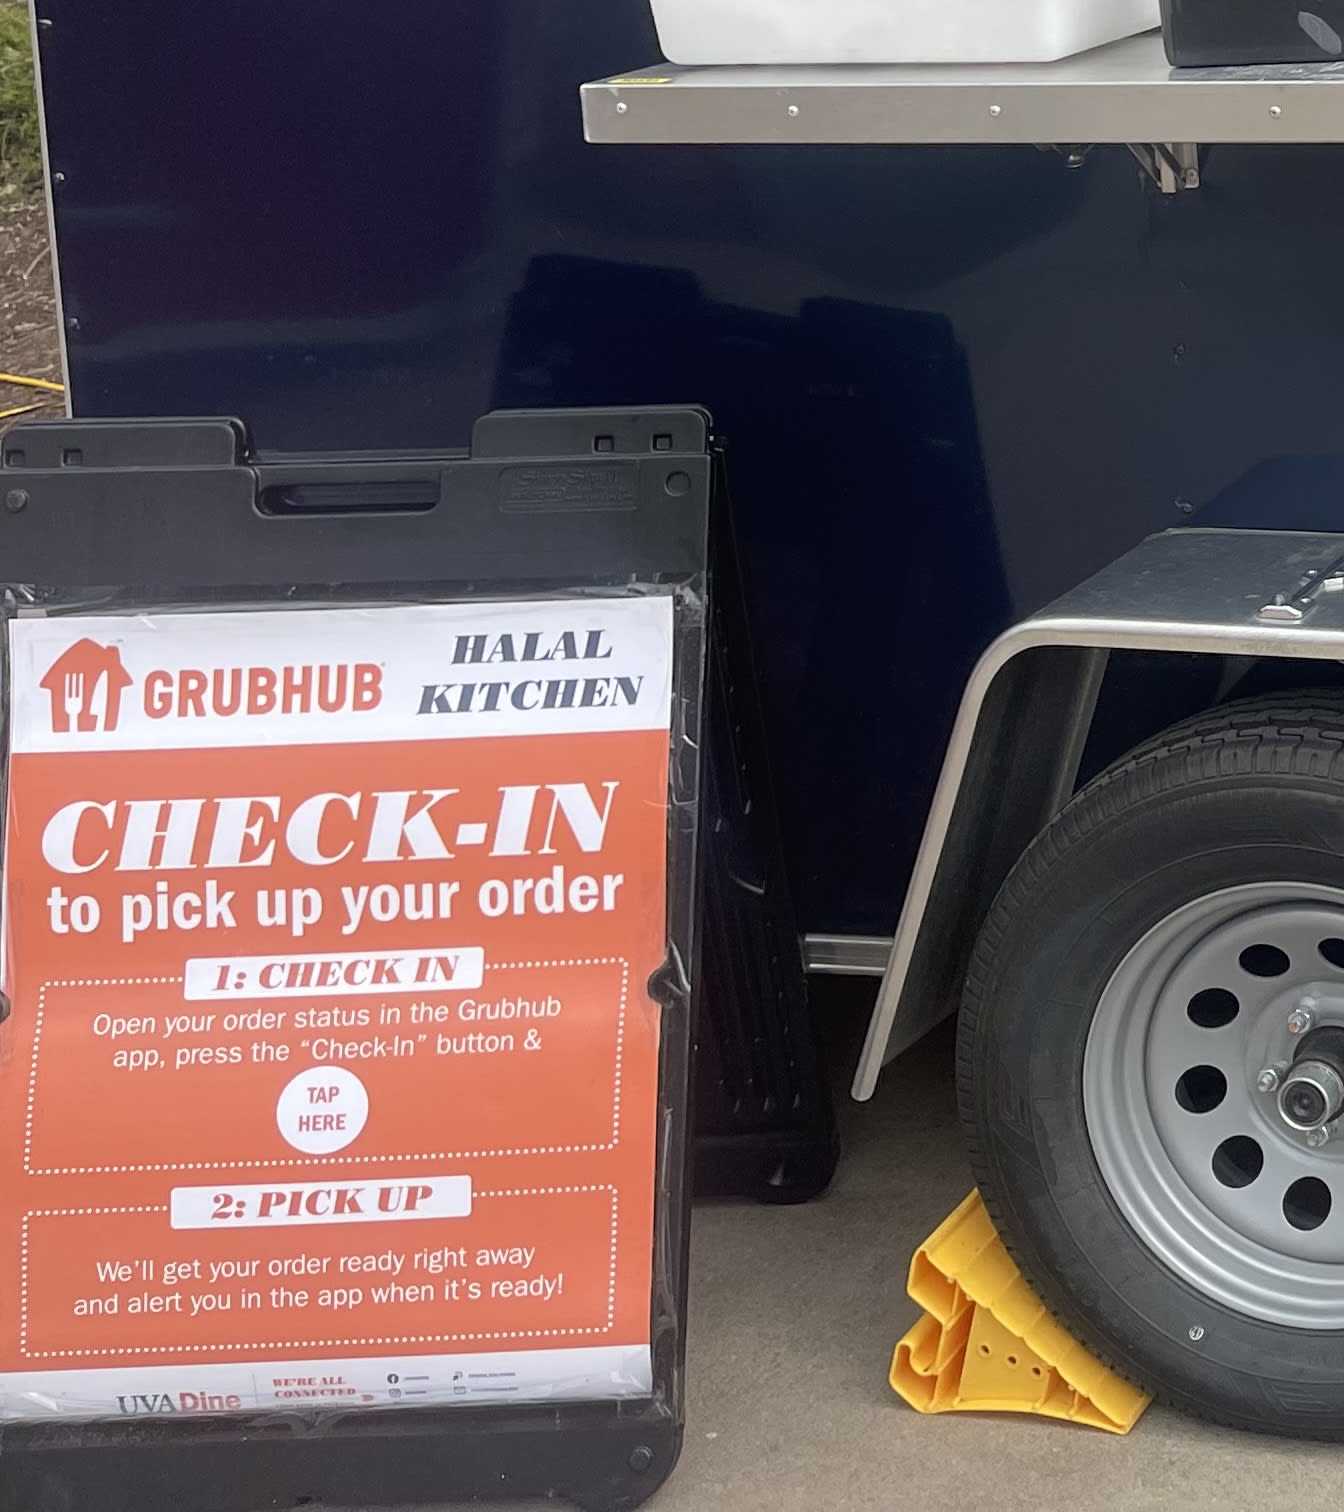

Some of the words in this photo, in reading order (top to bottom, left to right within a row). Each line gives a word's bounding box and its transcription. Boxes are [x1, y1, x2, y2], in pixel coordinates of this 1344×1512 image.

[451, 628, 613, 665] HALAL
[142, 662, 384, 721] GRUBHUB
[416, 674, 644, 716] KITCHEN
[40, 781, 620, 875] CHECK-IN
[47, 888, 100, 934] to
[122, 880, 237, 944] pick
[256, 886, 323, 937] up
[342, 880, 461, 935] your
[479, 865, 624, 917] order
[211, 963, 247, 993] 1:
[258, 957, 408, 990] CHECK
[413, 954, 461, 984] IN
[92, 1013, 157, 1041] Open
[164, 1012, 215, 1040] your
[223, 1006, 286, 1032] order
[295, 1005, 371, 1029] status
[378, 1002, 402, 1024] in
[410, 999, 450, 1023] the
[458, 994, 562, 1021] Grubhub
[112, 1045, 166, 1070] app,
[175, 1043, 243, 1068] press
[251, 1040, 290, 1063] the
[435, 1029, 515, 1054] button
[523, 1029, 543, 1052] &
[306, 1085, 341, 1105] TAP
[297, 1112, 348, 1132] HERE
[211, 1193, 245, 1221] 2:
[257, 1187, 363, 1218] PICK
[376, 1184, 434, 1214] UP
[162, 1259, 201, 1285] get
[209, 1257, 260, 1282] your
[267, 1252, 331, 1277] order
[338, 1248, 406, 1275] ready
[413, 1245, 467, 1272] right
[474, 1245, 535, 1270] away
[274, 1388, 357, 1399] CONNECTED
